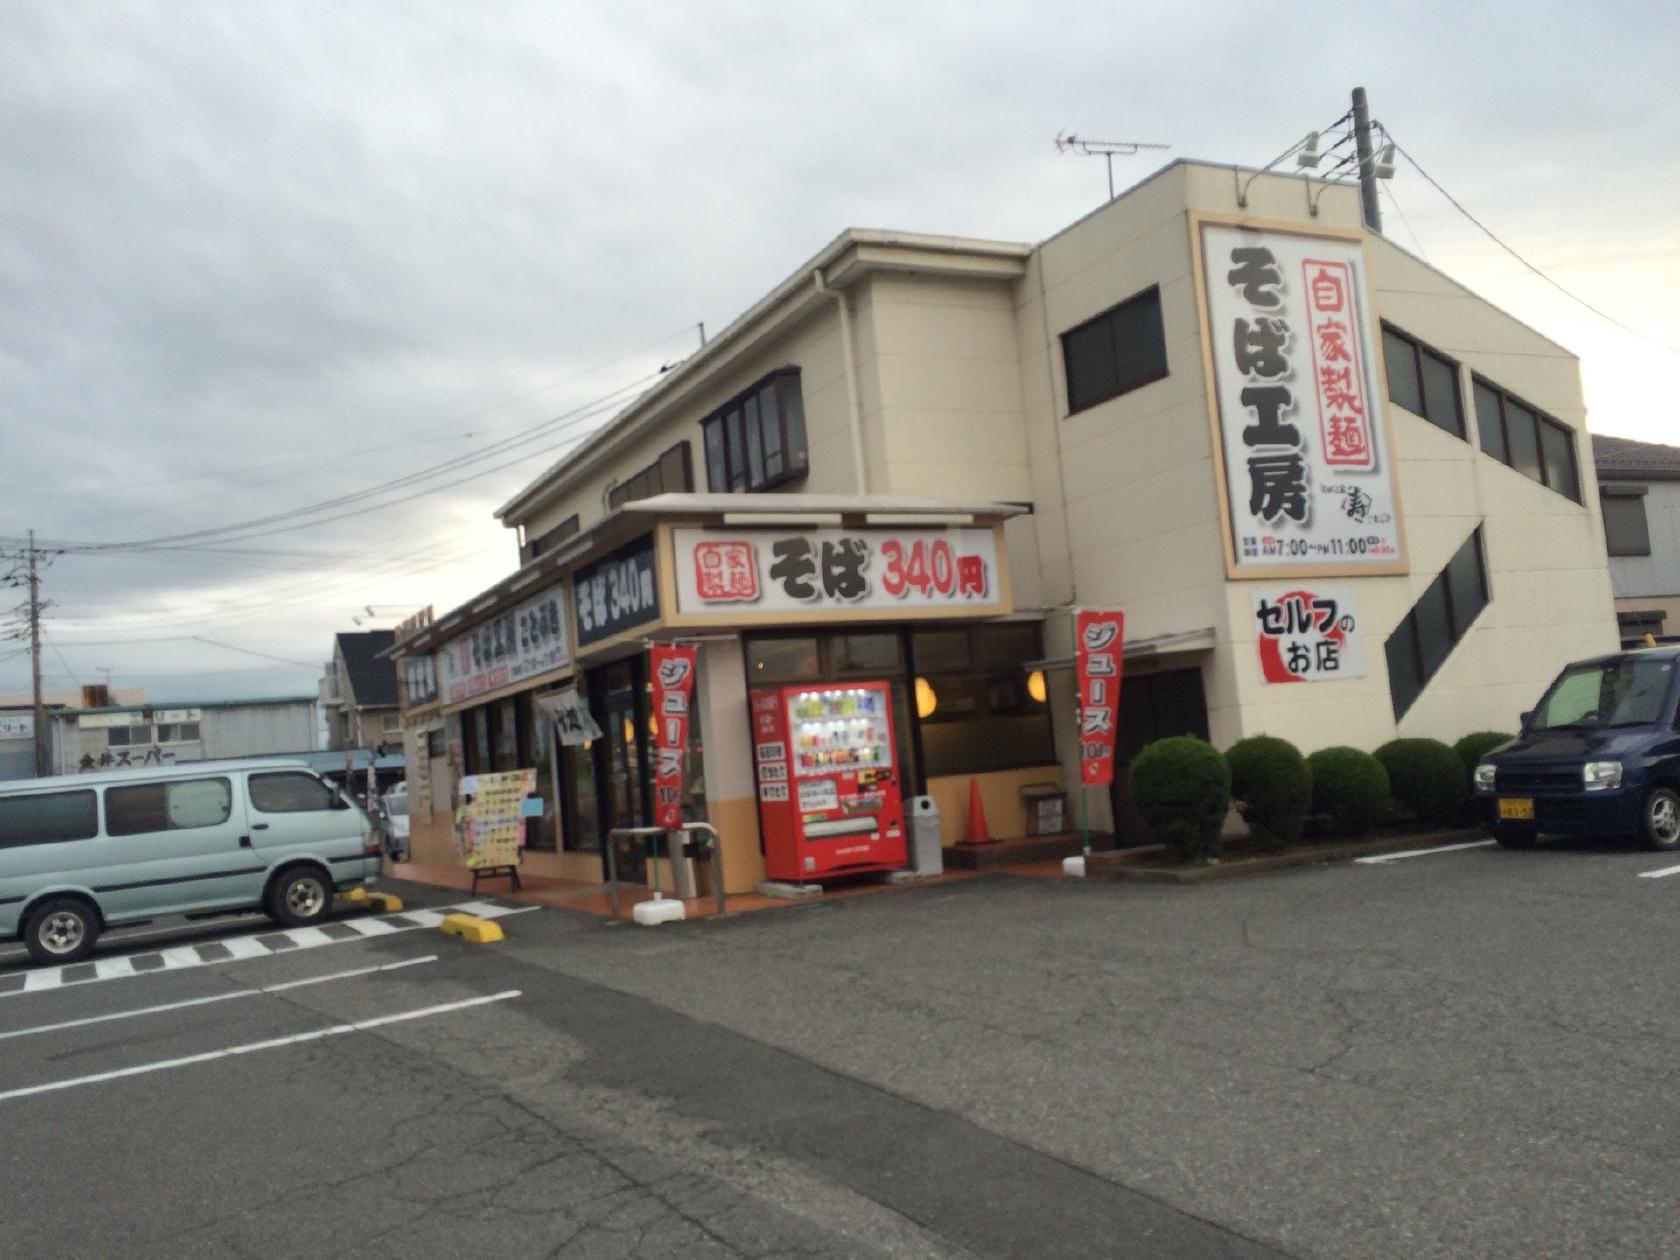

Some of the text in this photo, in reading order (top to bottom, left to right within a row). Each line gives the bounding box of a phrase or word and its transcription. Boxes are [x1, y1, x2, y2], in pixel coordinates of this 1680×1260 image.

[1227, 246, 1307, 521] そば工房
[769, 536, 984, 600] そば 340円
[1256, 598, 1356, 635] セルフの
[1082, 621, 1118, 736] ジュース
[1287, 640, 1339, 674] お店
